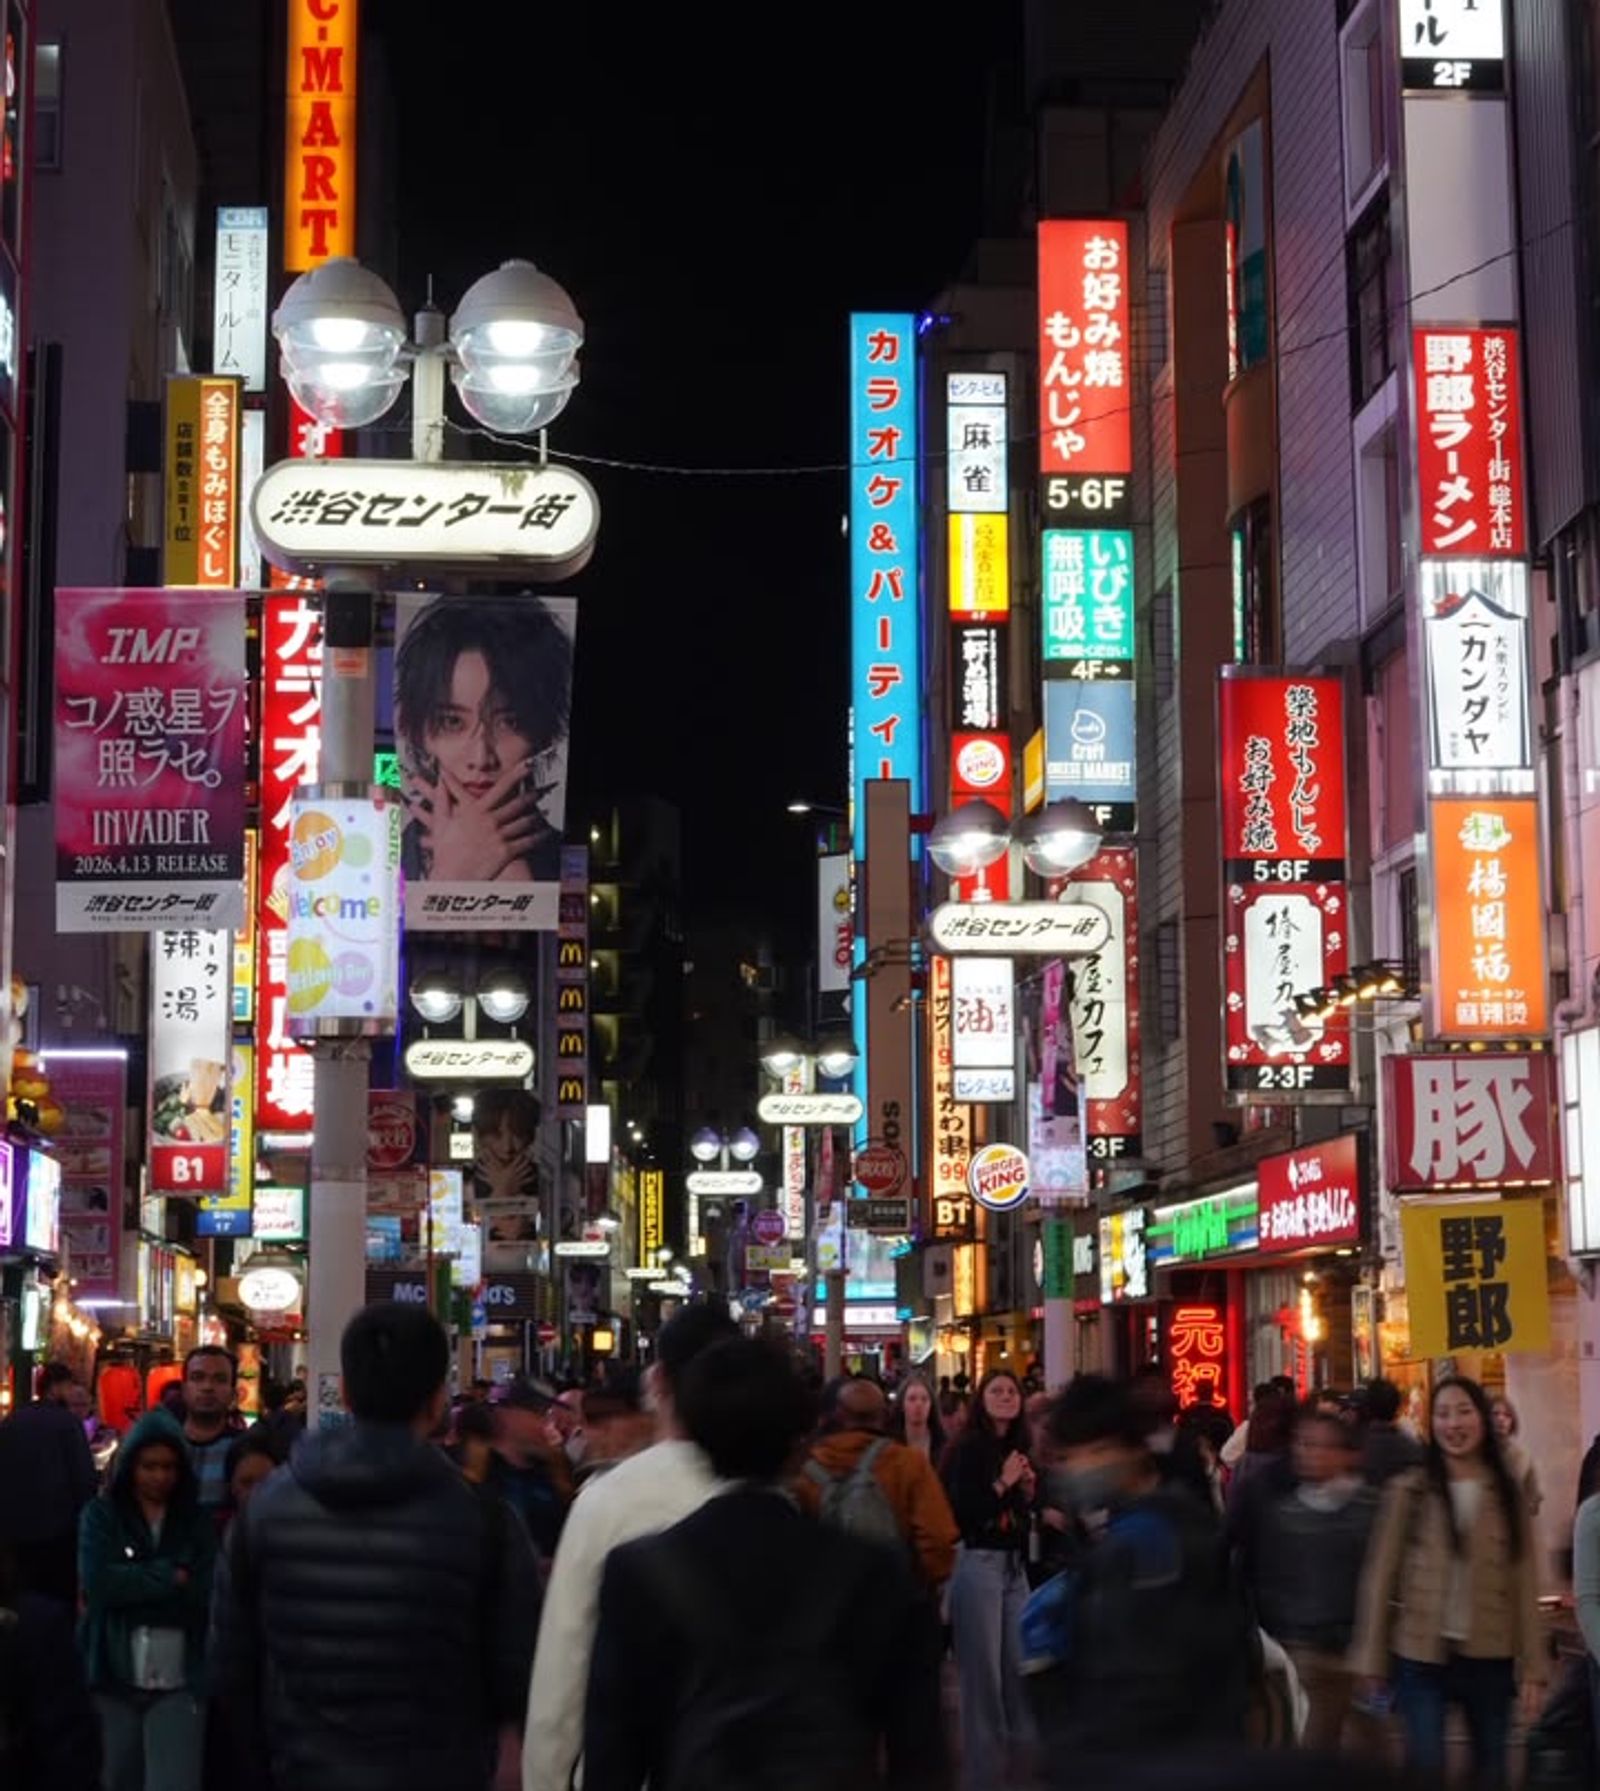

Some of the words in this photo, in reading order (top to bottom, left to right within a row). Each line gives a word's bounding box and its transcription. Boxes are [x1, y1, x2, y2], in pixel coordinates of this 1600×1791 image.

[1433, 62, 1472, 86] 2F
[220, 233, 241, 369] モニタールーム
[1083, 235, 1123, 388] お好み焼
[1044, 311, 1086, 460] もんじゃ
[963, 422, 992, 493] 麻雀
[1425, 335, 1477, 549] 野郎ラーメン
[1484, 336, 1513, 549] 渋谷センター街総本店
[204, 391, 229, 577] 全身もみほぐし
[270, 490, 577, 530] 渋谷センター街
[1049, 534, 1085, 641] 無呼吸
[1090, 534, 1129, 640] いびき
[1071, 661, 1102, 680] 4F
[64, 688, 238, 735] コノ惑星ヲ
[98, 739, 222, 788] 照ラセ。
[1240, 735, 1277, 852] お好み焼
[1285, 684, 1321, 854] 築地もんじゃ
[93, 809, 210, 844] INVADER
[75, 856, 150, 873] 2026.4.13
[157, 855, 228, 872] RELEASE
[85, 894, 218, 912] 渋谷センター街
[942, 917, 1099, 936] 渋谷センター街
[957, 997, 994, 1034] 油
[1409, 1057, 1536, 1180] 豚
[172, 1156, 203, 1182] B1
[976, 1156, 1023, 1178] BURGER
[980, 1167, 1025, 1194] KING
[1440, 1216, 1512, 1351] 野郎
